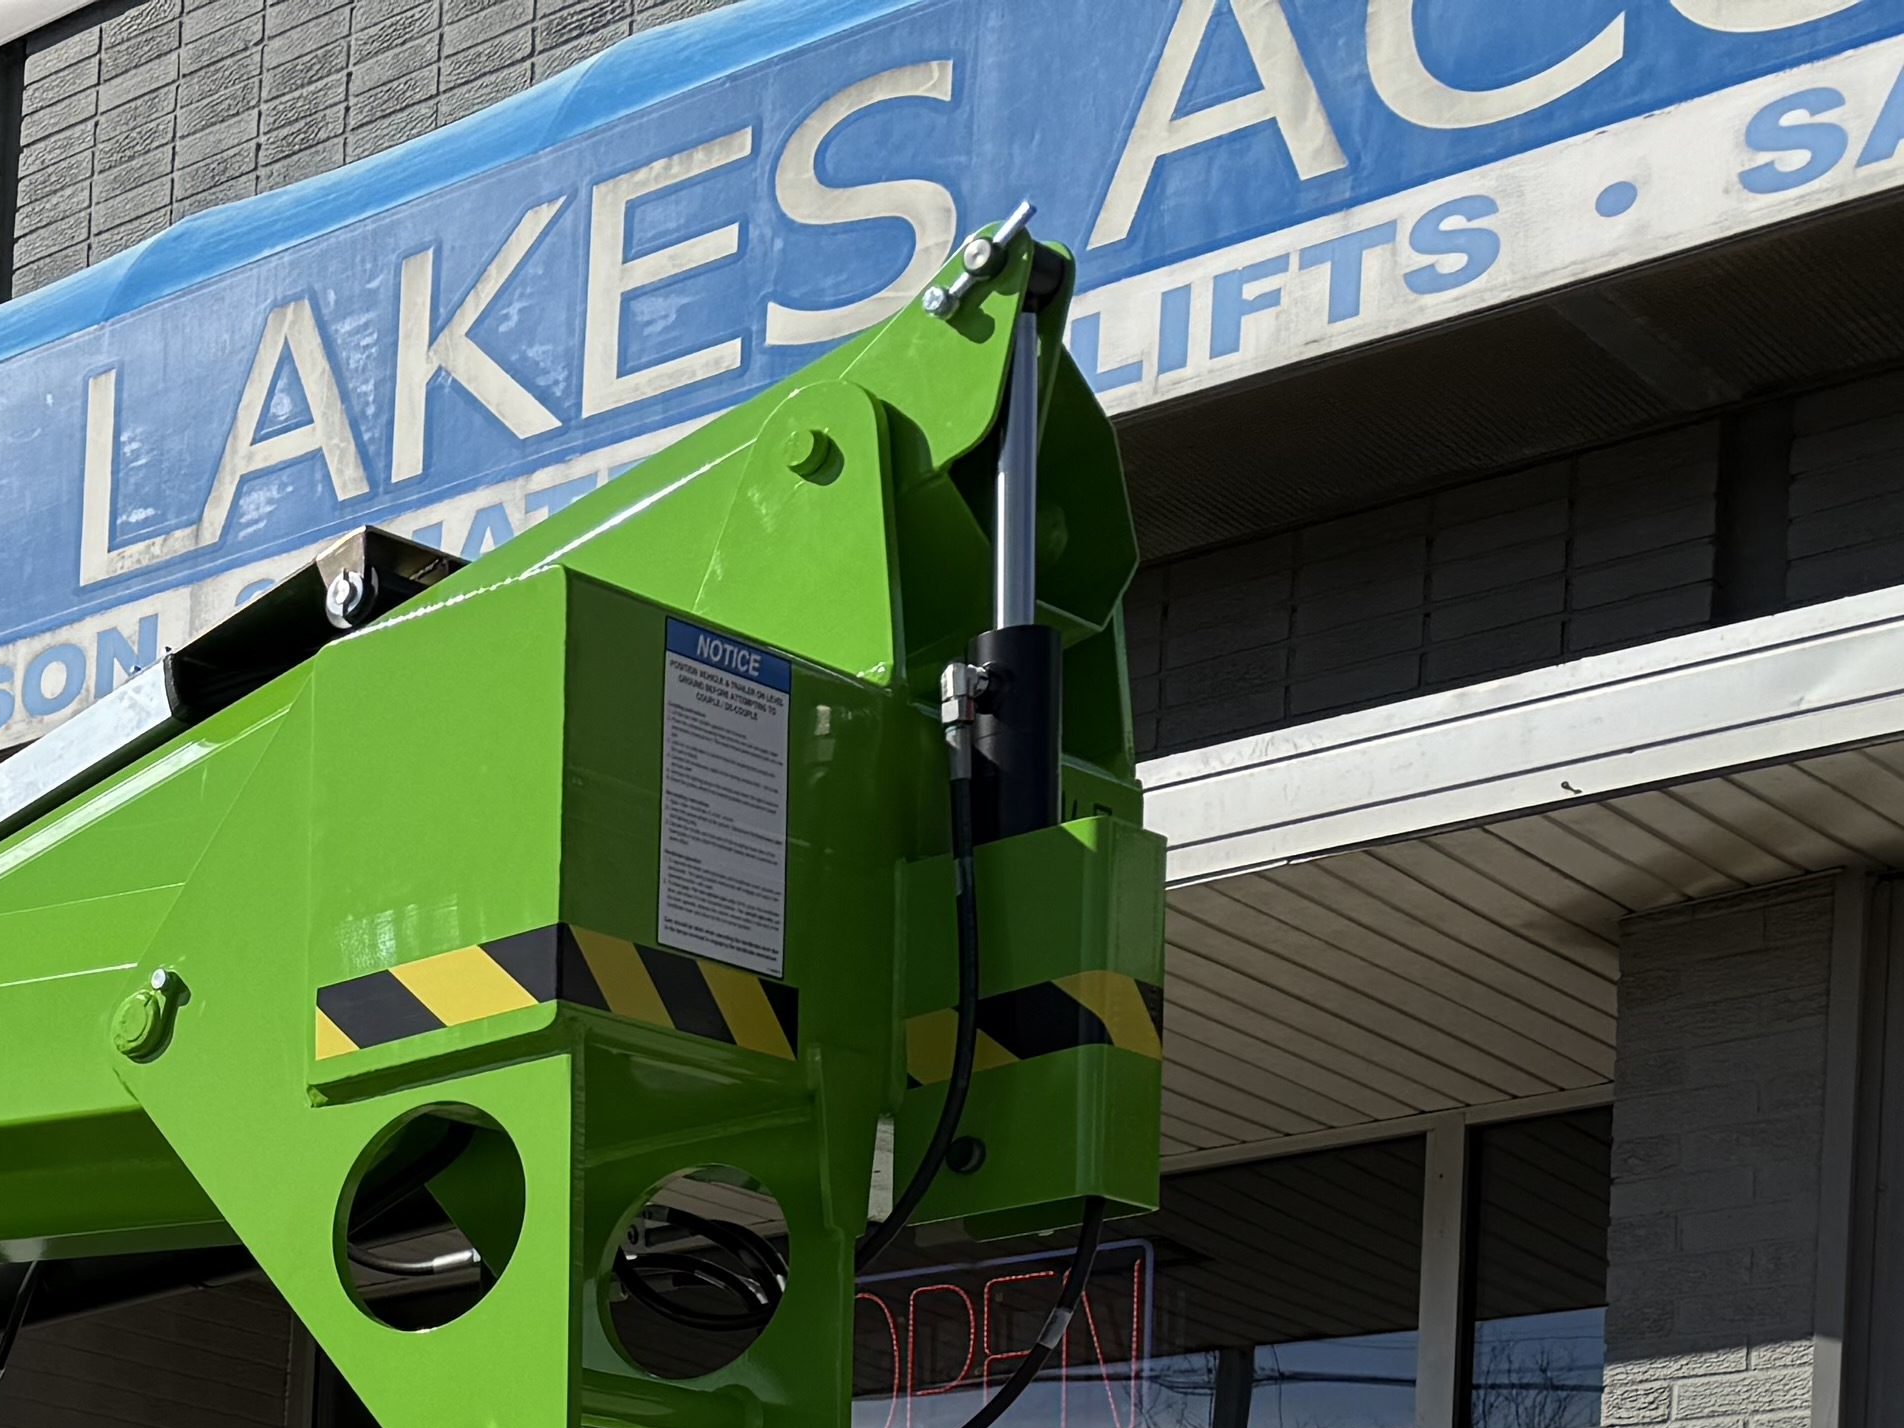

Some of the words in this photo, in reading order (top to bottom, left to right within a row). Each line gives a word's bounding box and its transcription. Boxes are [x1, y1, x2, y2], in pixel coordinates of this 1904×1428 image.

[79, 59, 957, 588] LAKES
[1070, 194, 1501, 394] LIFTS
[697, 634, 762, 677] NOTICE
